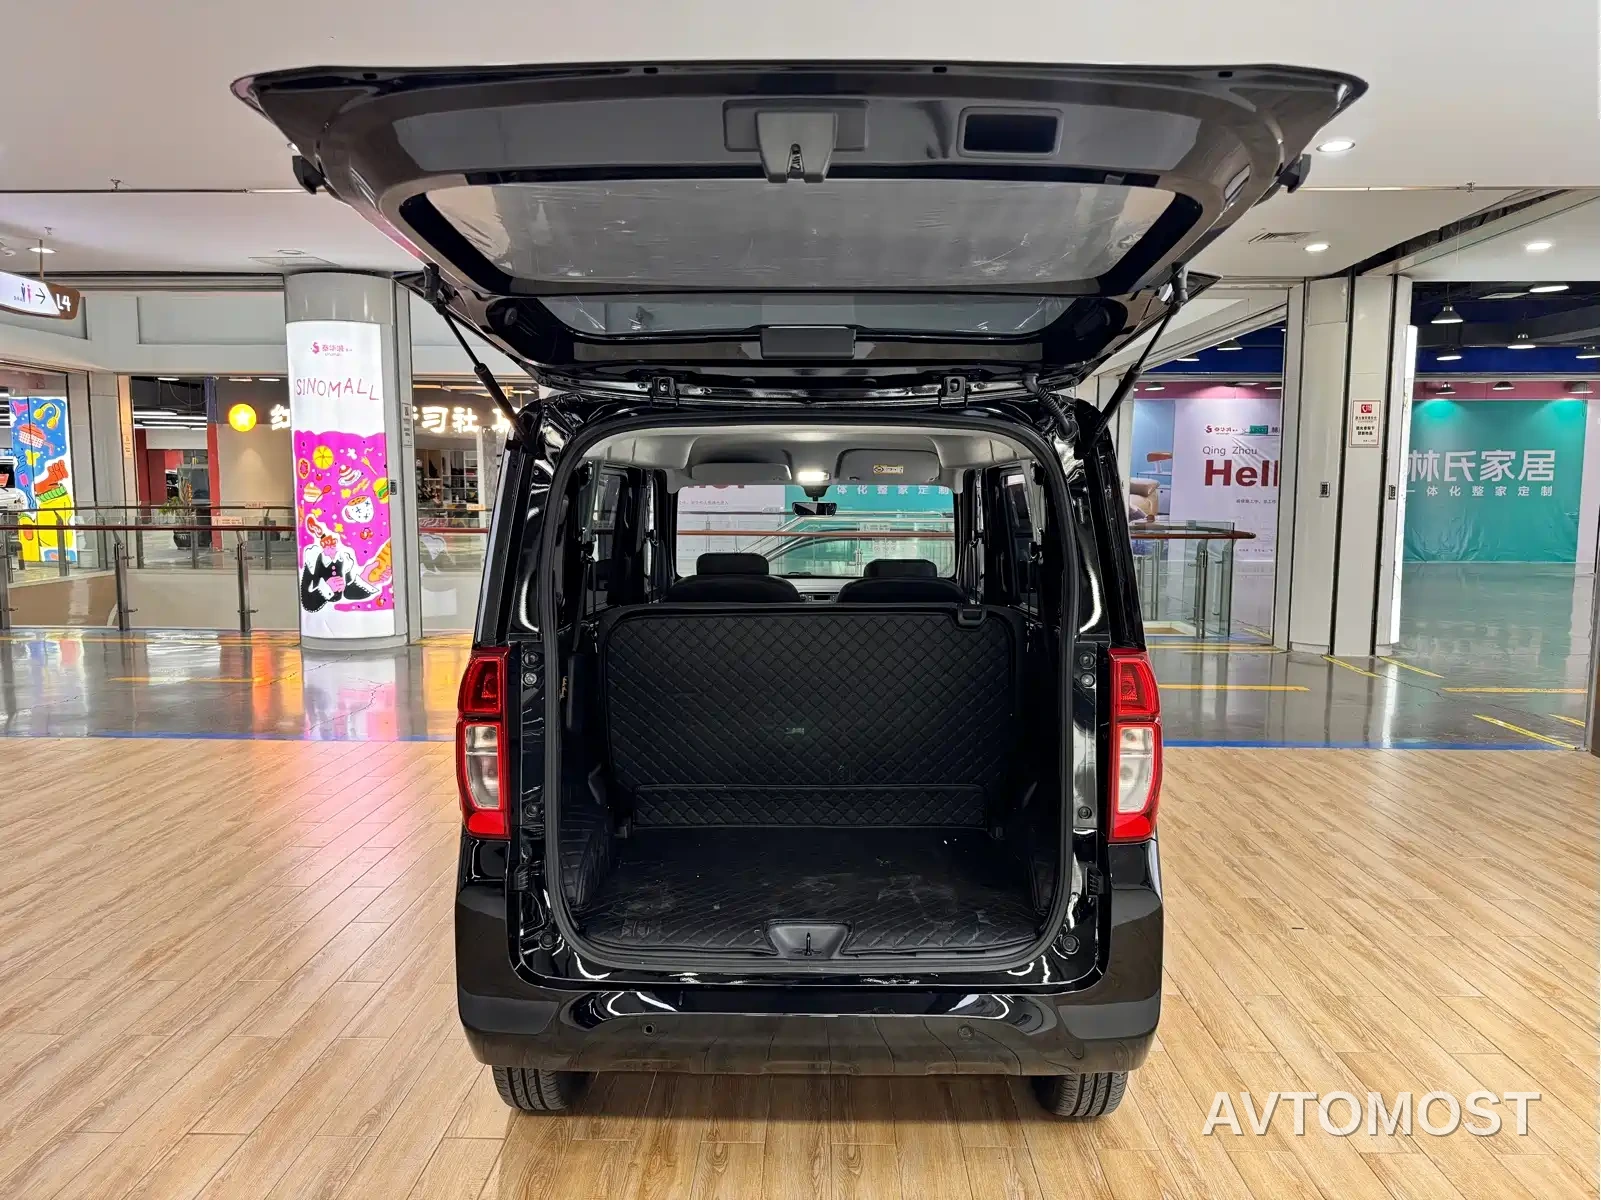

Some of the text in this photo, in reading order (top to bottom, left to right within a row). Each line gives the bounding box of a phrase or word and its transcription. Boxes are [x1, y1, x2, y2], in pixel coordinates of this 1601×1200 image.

[56, 293, 71, 312] L4
[296, 378, 379, 401] SINOMALL
[1202, 445, 1258, 456] Qing Zhou
[1408, 449, 1556, 482] 林氏家居
[1406, 485, 1554, 497] 一体化整家定制
